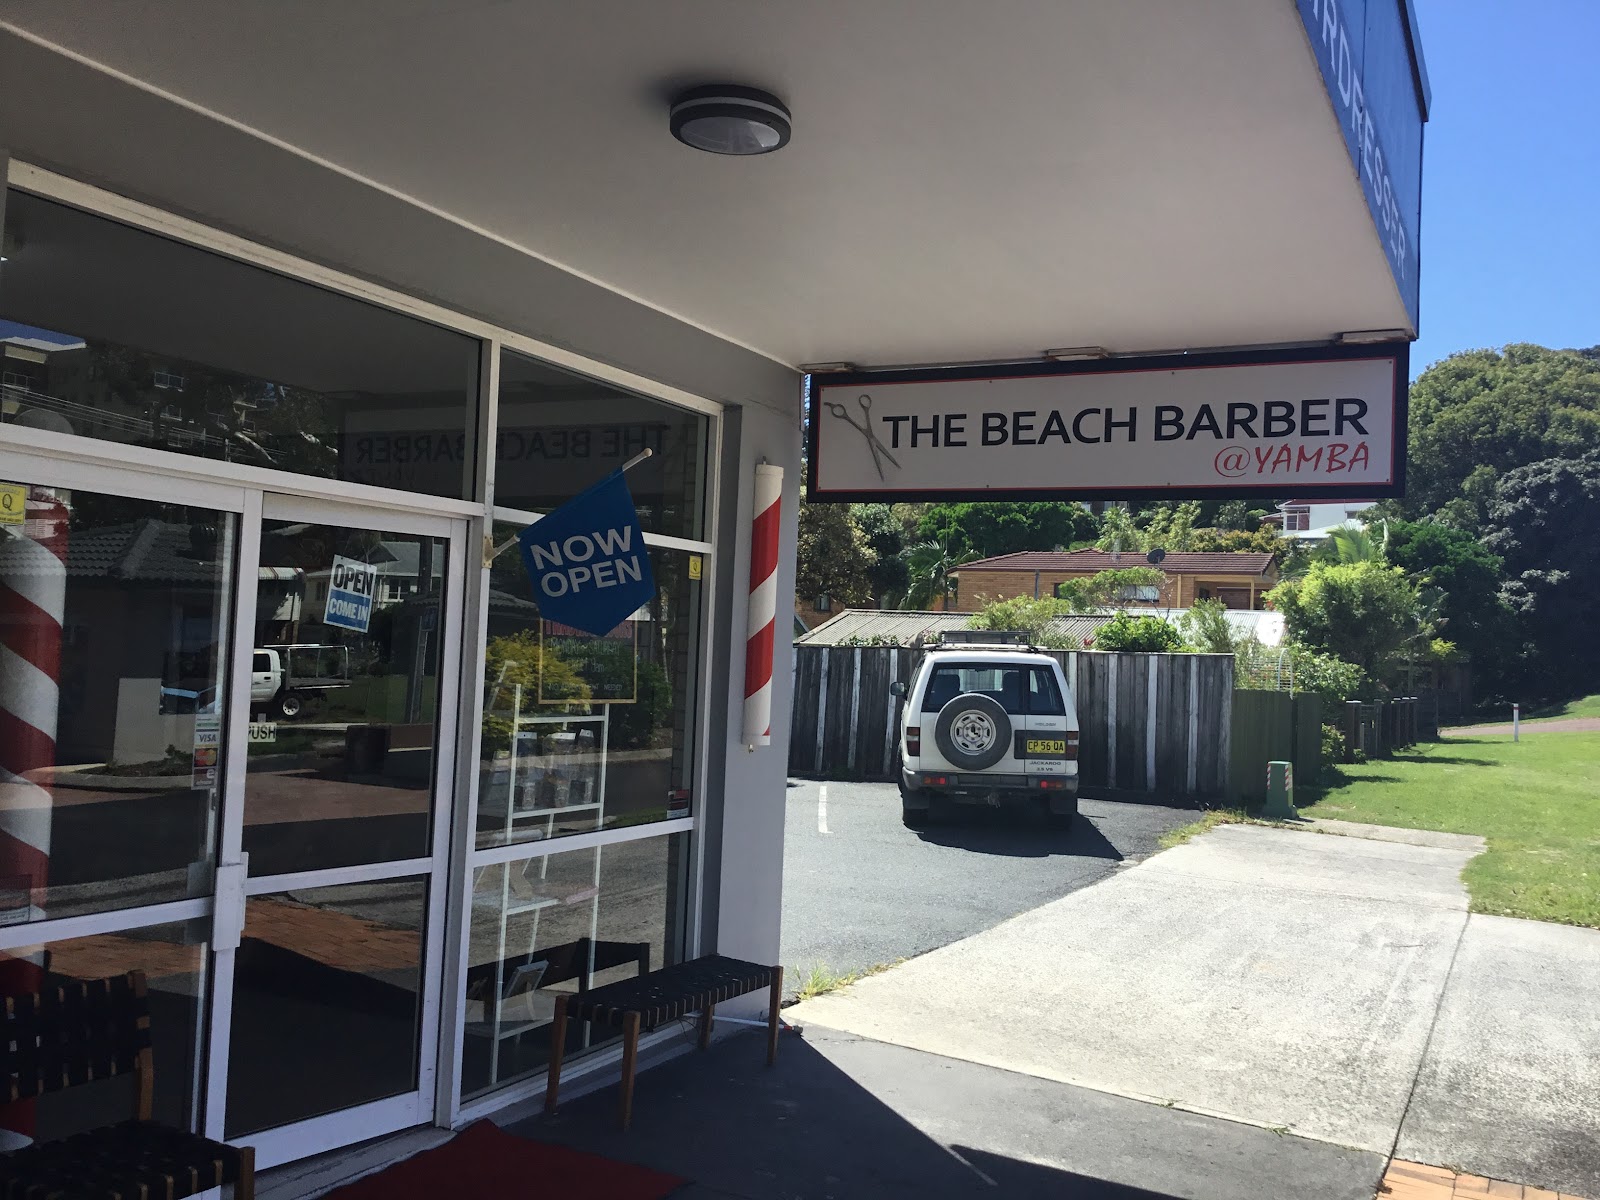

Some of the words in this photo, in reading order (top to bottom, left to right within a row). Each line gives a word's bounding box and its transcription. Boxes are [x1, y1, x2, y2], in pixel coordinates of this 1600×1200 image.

[882, 414, 967, 448] THE
[981, 406, 1137, 446] BEACH
[1154, 397, 1369, 441] BARBER
[1214, 441, 1369, 478] @YAMBA
[530, 525, 632, 570] NOW
[333, 563, 374, 596] OPEN
[541, 555, 643, 598] OPEN
[328, 598, 358, 619] COME
[357, 605, 369, 621] IN
[199, 733, 217, 742] VISA
[248, 725, 276, 740] USH
[1028, 741, 1039, 750] CP
[1040, 741, 1051, 750] 56
